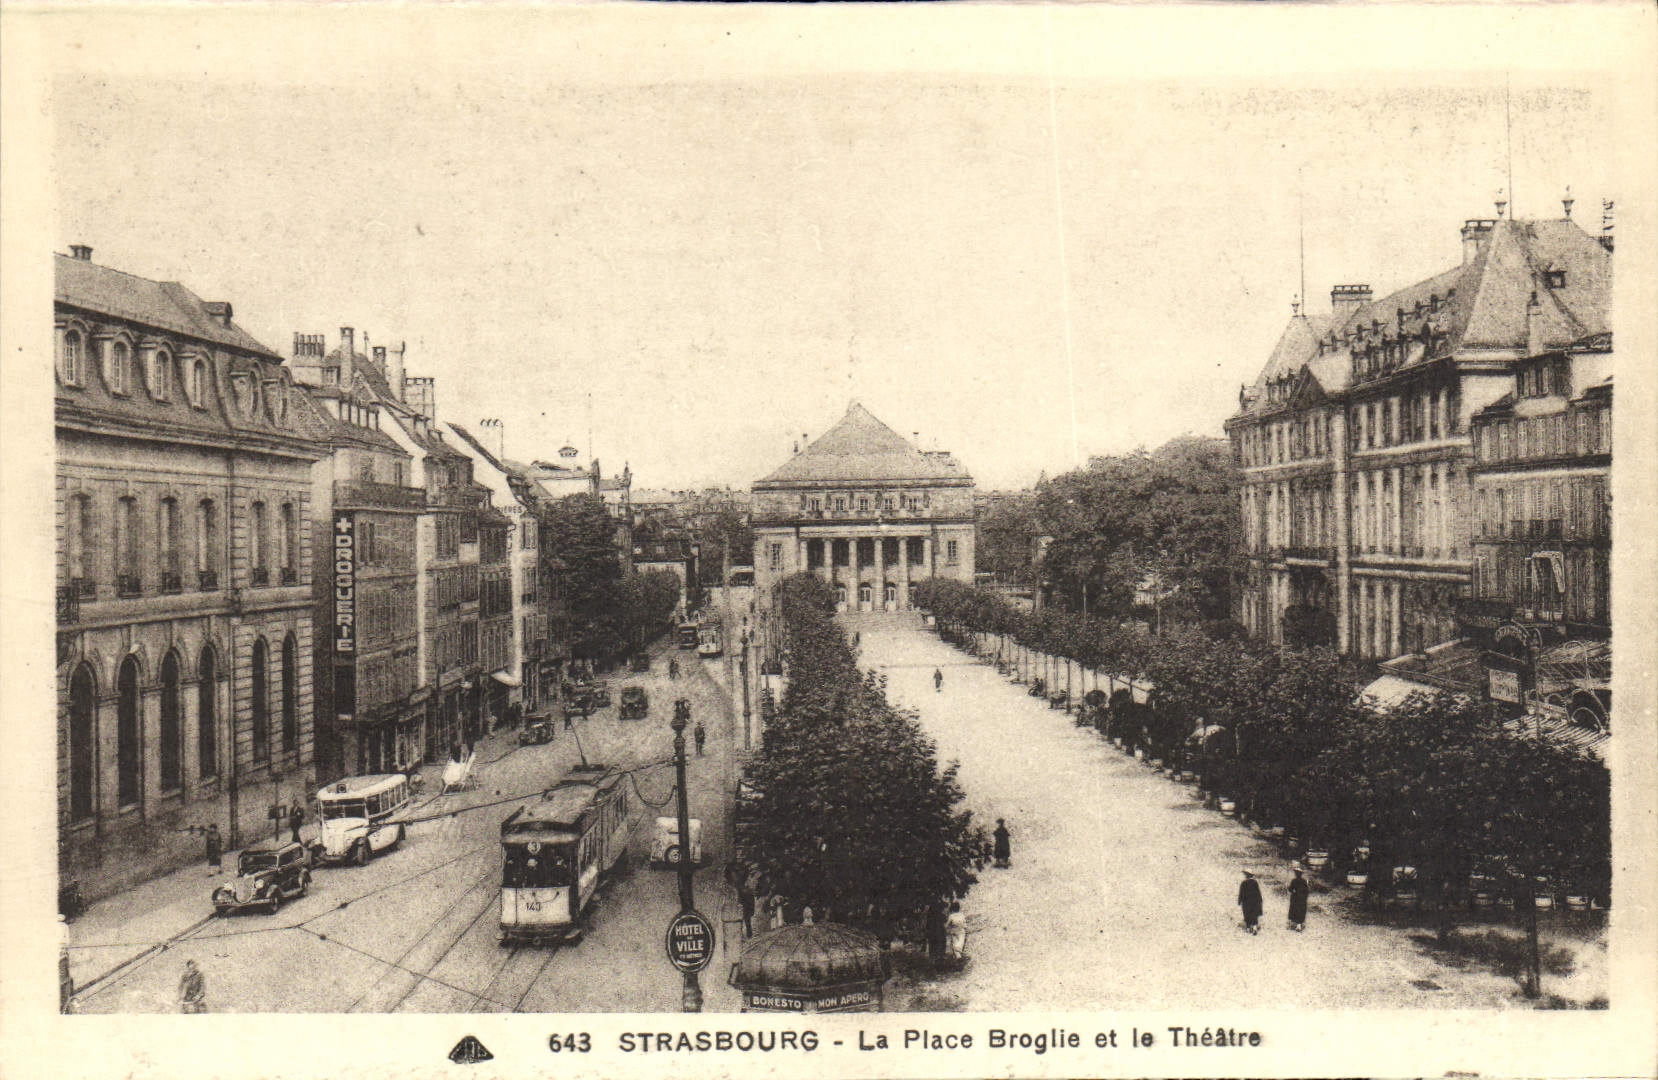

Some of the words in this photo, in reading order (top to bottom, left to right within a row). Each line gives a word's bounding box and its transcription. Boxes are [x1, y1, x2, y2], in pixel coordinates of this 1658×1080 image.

[335, 534, 354, 652] DROGUERIE
[675, 922, 705, 937] HÔTEL
[676, 940, 704, 953] VILLE
[817, 997, 837, 1009] MON
